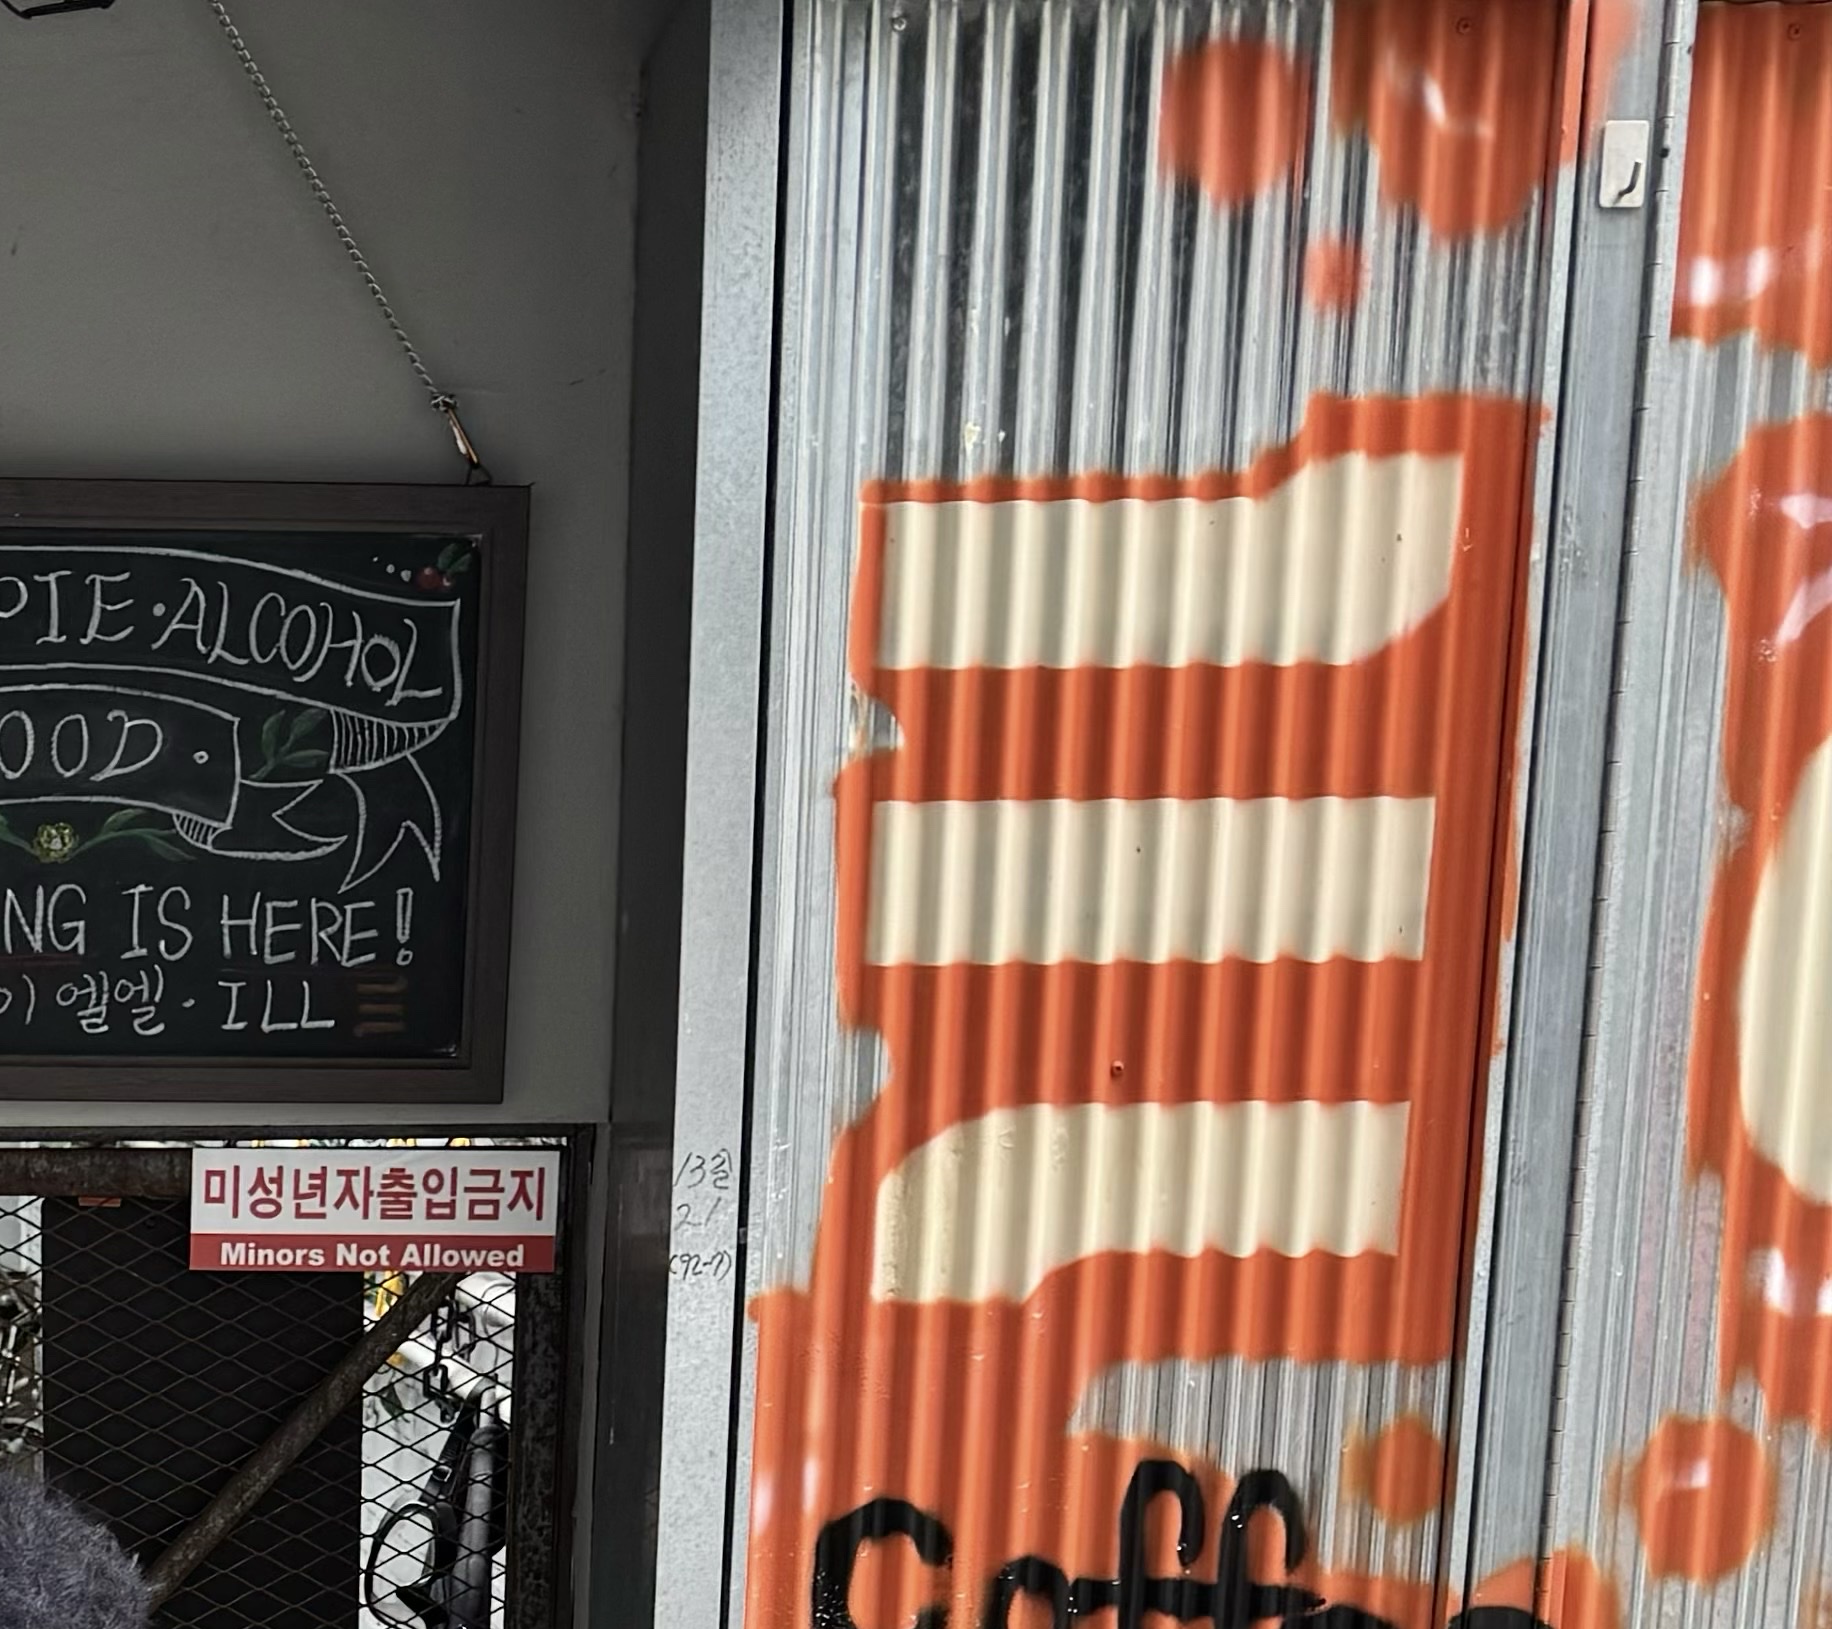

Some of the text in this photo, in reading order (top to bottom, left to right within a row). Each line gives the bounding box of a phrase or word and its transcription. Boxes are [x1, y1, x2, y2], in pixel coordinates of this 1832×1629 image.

[151, 577, 442, 706] ALCOHOL
[120, 883, 194, 961] IS
[220, 887, 414, 967] HERE!
[218, 979, 335, 1032] ILL
[202, 1164, 545, 1221] 미성년자출입금지
[220, 1242, 524, 1268] Minors Not Allowed
